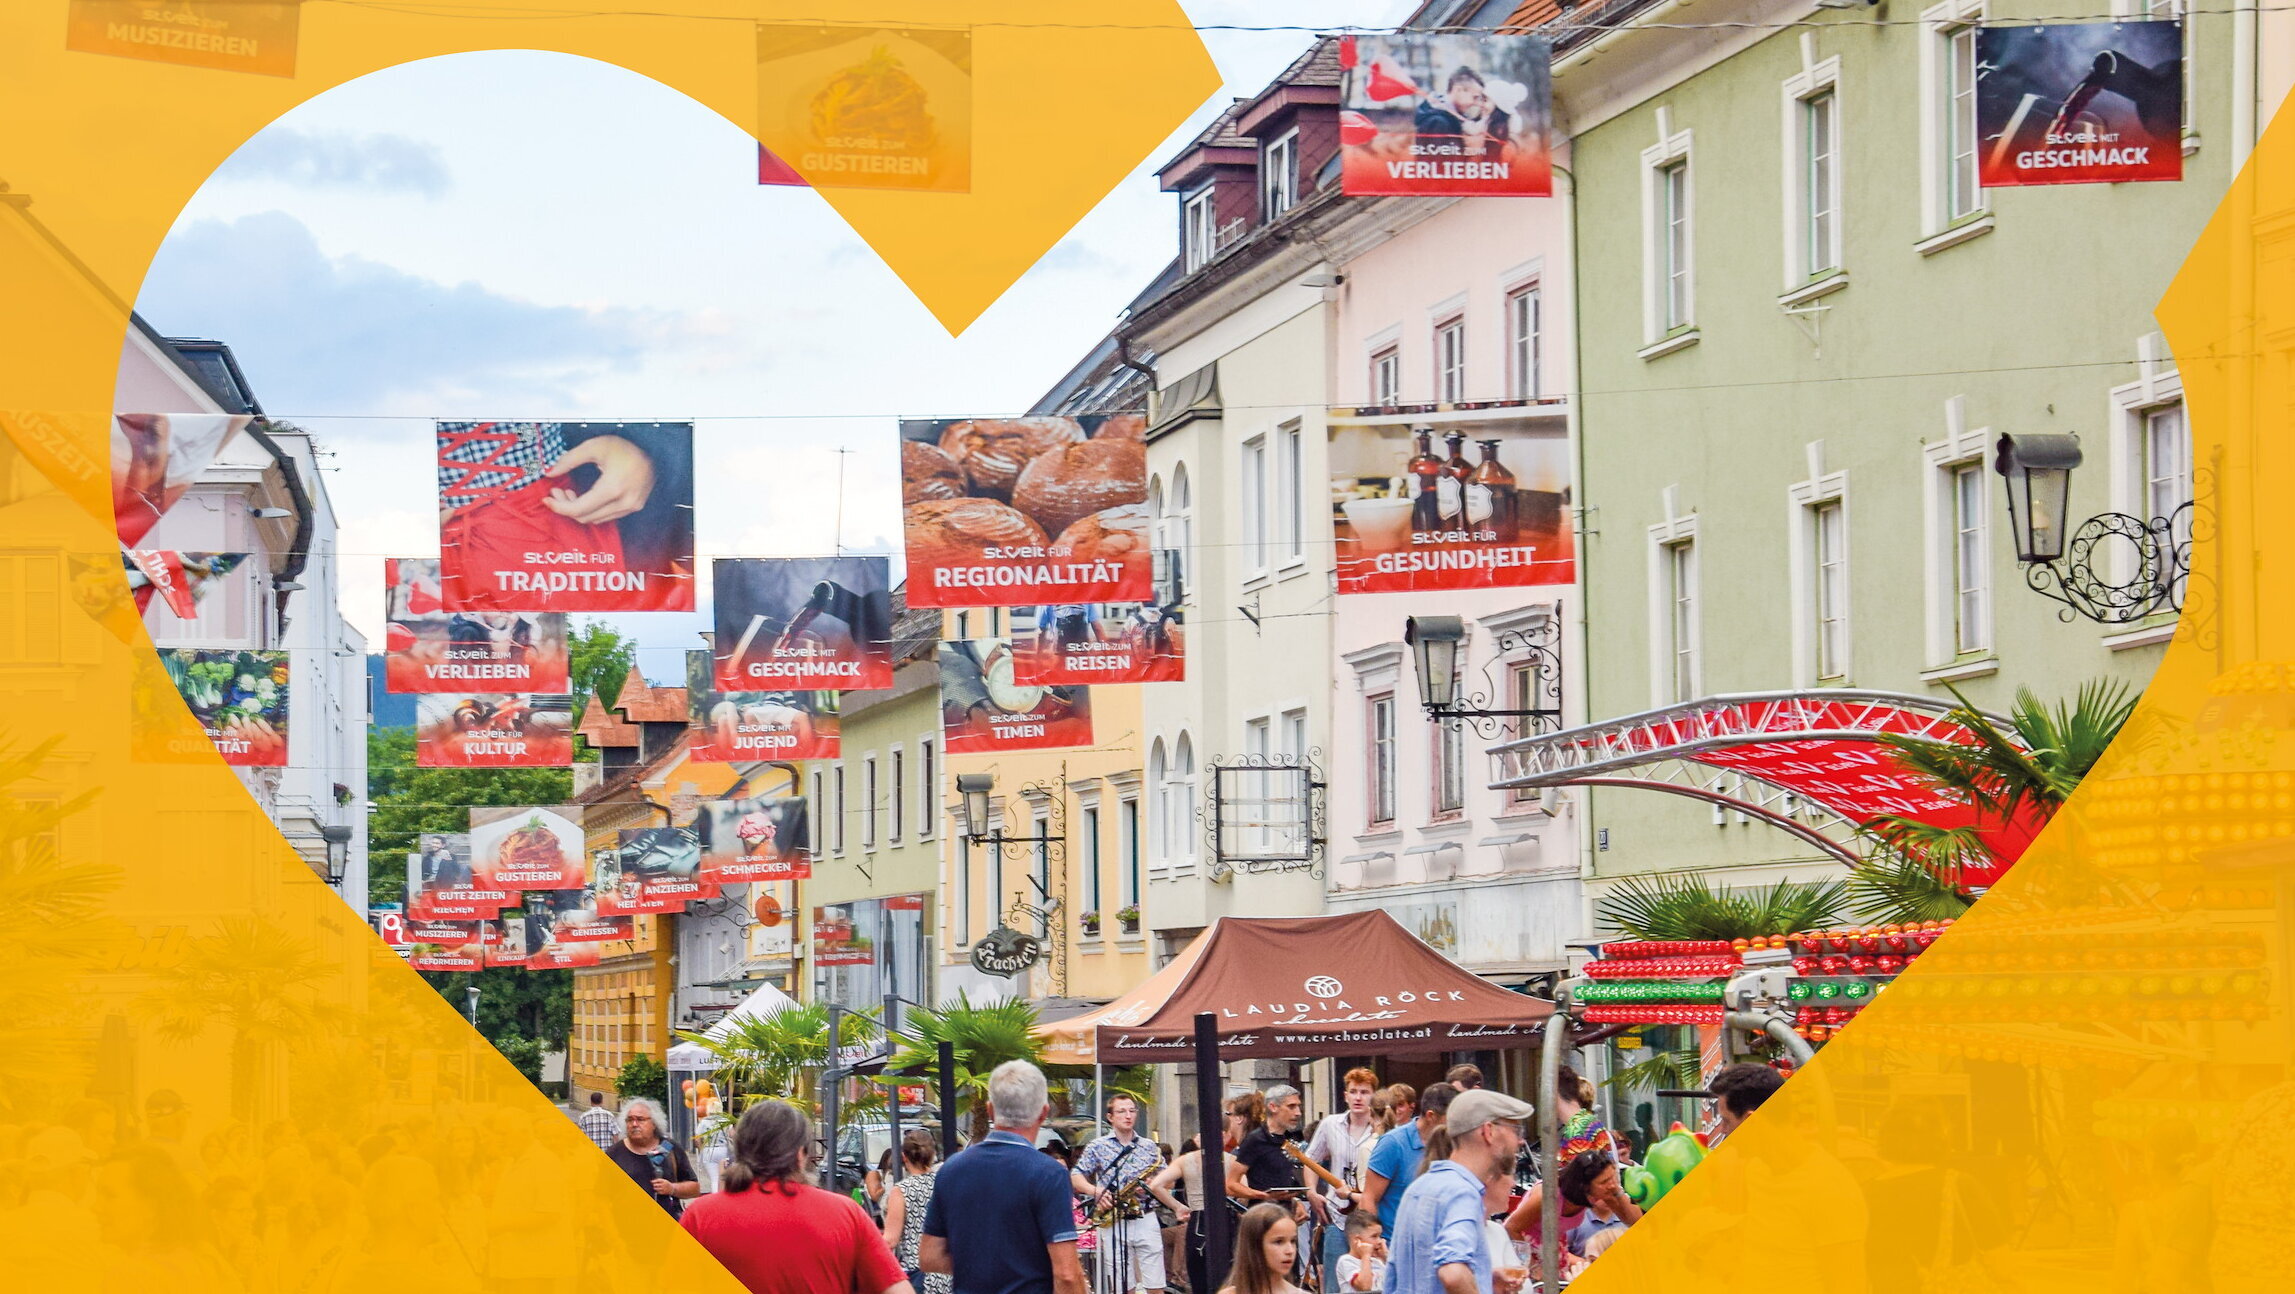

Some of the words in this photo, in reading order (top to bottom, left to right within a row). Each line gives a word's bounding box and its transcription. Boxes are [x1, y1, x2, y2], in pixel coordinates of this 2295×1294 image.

[106, 21, 258, 57] MUSIZIEREN
[2100, 133, 2120, 143] MIT
[1463, 147, 1487, 155] ZUM
[802, 152, 928, 175] GUSTIEREN
[2016, 147, 2149, 169] GESCHMACK
[1387, 161, 1509, 180] VERLIEBEN
[1473, 530, 1497, 542] FÜR
[590, 552, 615, 565] FÜR
[1048, 546, 1072, 558] FÜR
[1375, 547, 1537, 573] GESUNDHEIT
[934, 559, 1124, 587] REGIONALITÄT
[494, 570, 645, 592] TRADITION
[821, 649, 837, 657] MIT
[1112, 642, 1131, 651] ZUM
[491, 651, 511, 660] ZUM
[748, 661, 861, 677] GESCHMACK
[1065, 655, 1131, 671] REISEN
[424, 664, 530, 679] VERLIEBEN
[1029, 714, 1046, 722] ZUM
[992, 725, 1045, 740] TIMEN
[463, 742, 528, 756] KULTUR
[733, 735, 798, 750] JUGEND
[721, 863, 792, 876] SCHMECKEN
[495, 871, 562, 883] GUSTIEREN
[644, 883, 698, 895] ANZIEHEN
[438, 891, 466, 901] GUTE
[468, 891, 506, 900] ZEITEN
[617, 900, 664, 909] HEIATEN
[415, 930, 468, 939] MUSIZIEREN
[572, 927, 619, 937] GENIESSEN
[419, 958, 474, 966] REFORMIEREN
[554, 956, 572, 964] STIL
[1201, 1001, 1353, 1019] LAUDIA
[1375, 991, 1465, 1007] RÖCK
[1272, 1010, 1407, 1026] chocolate
[1114, 1034, 1187, 1049] handmade
[1275, 1028, 1431, 1043] www.cr-chocolate.at
[1446, 1023, 1517, 1038] handmade
